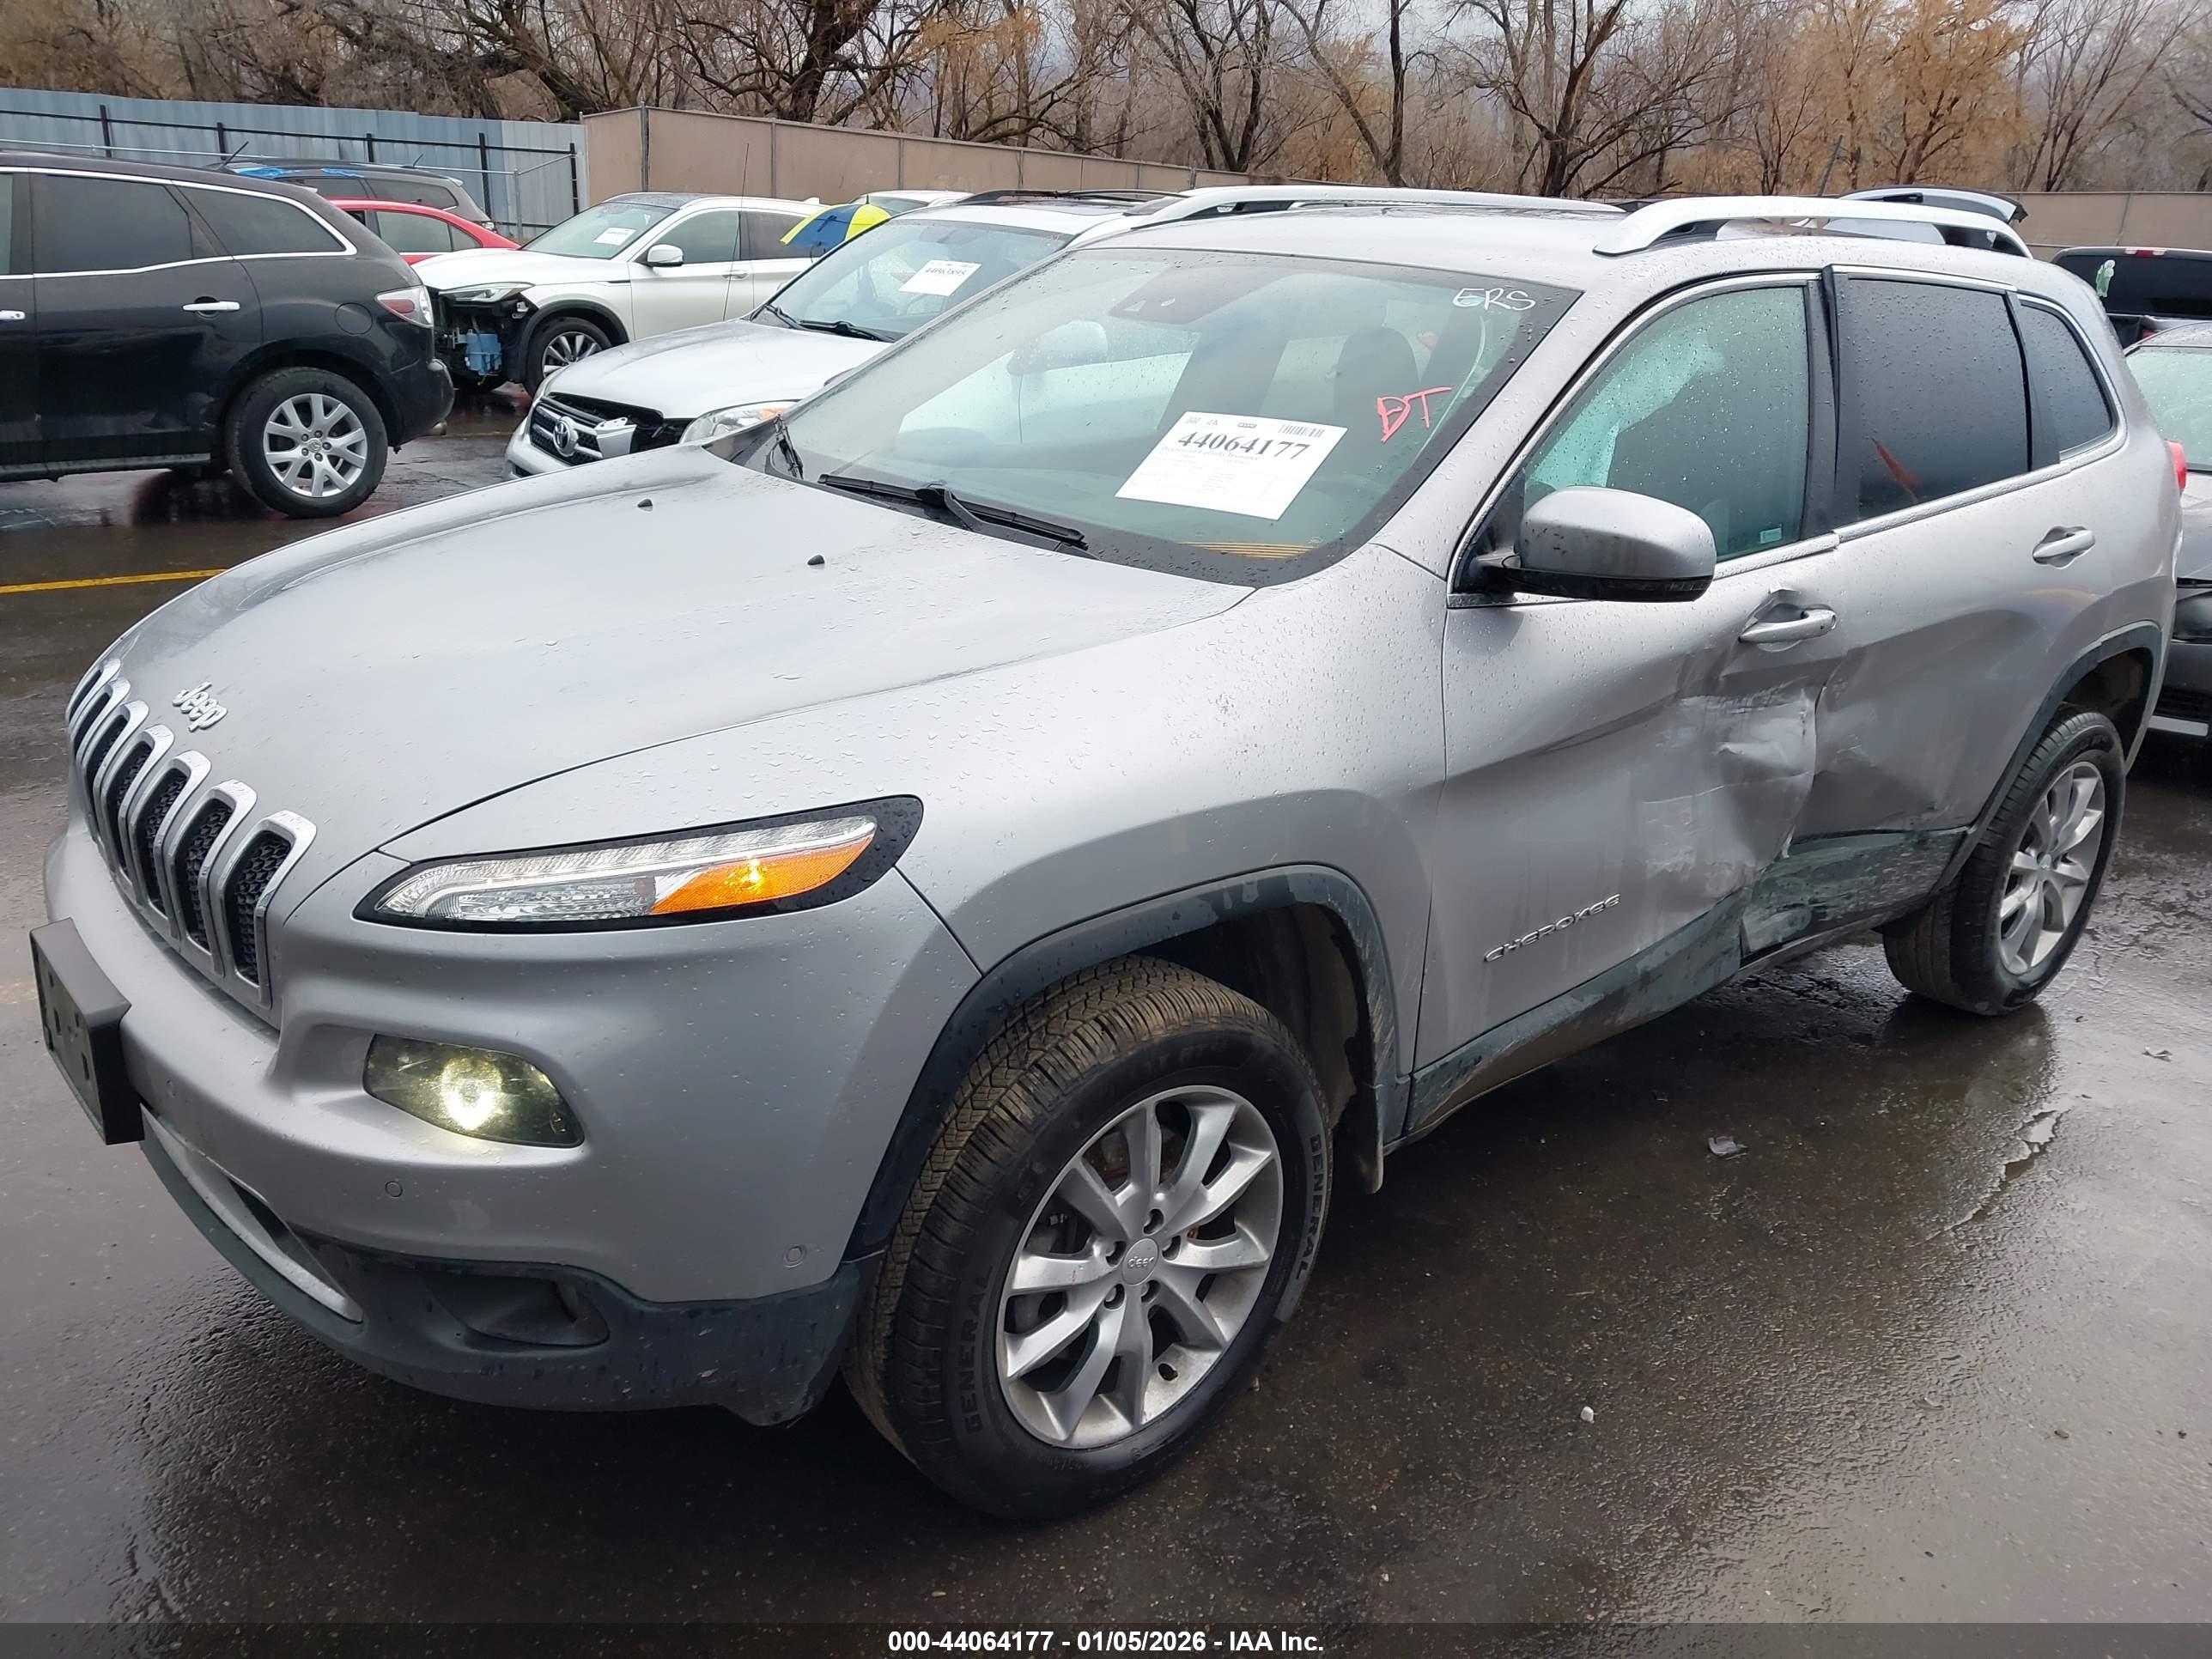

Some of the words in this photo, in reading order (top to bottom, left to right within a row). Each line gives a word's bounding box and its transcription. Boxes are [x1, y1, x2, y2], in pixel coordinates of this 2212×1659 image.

[1452, 288, 1536, 311] ERS
[1177, 431, 1312, 460] 44064177
[172, 681, 228, 732] Jeep
[1484, 893, 1621, 963] CHEROKEE
